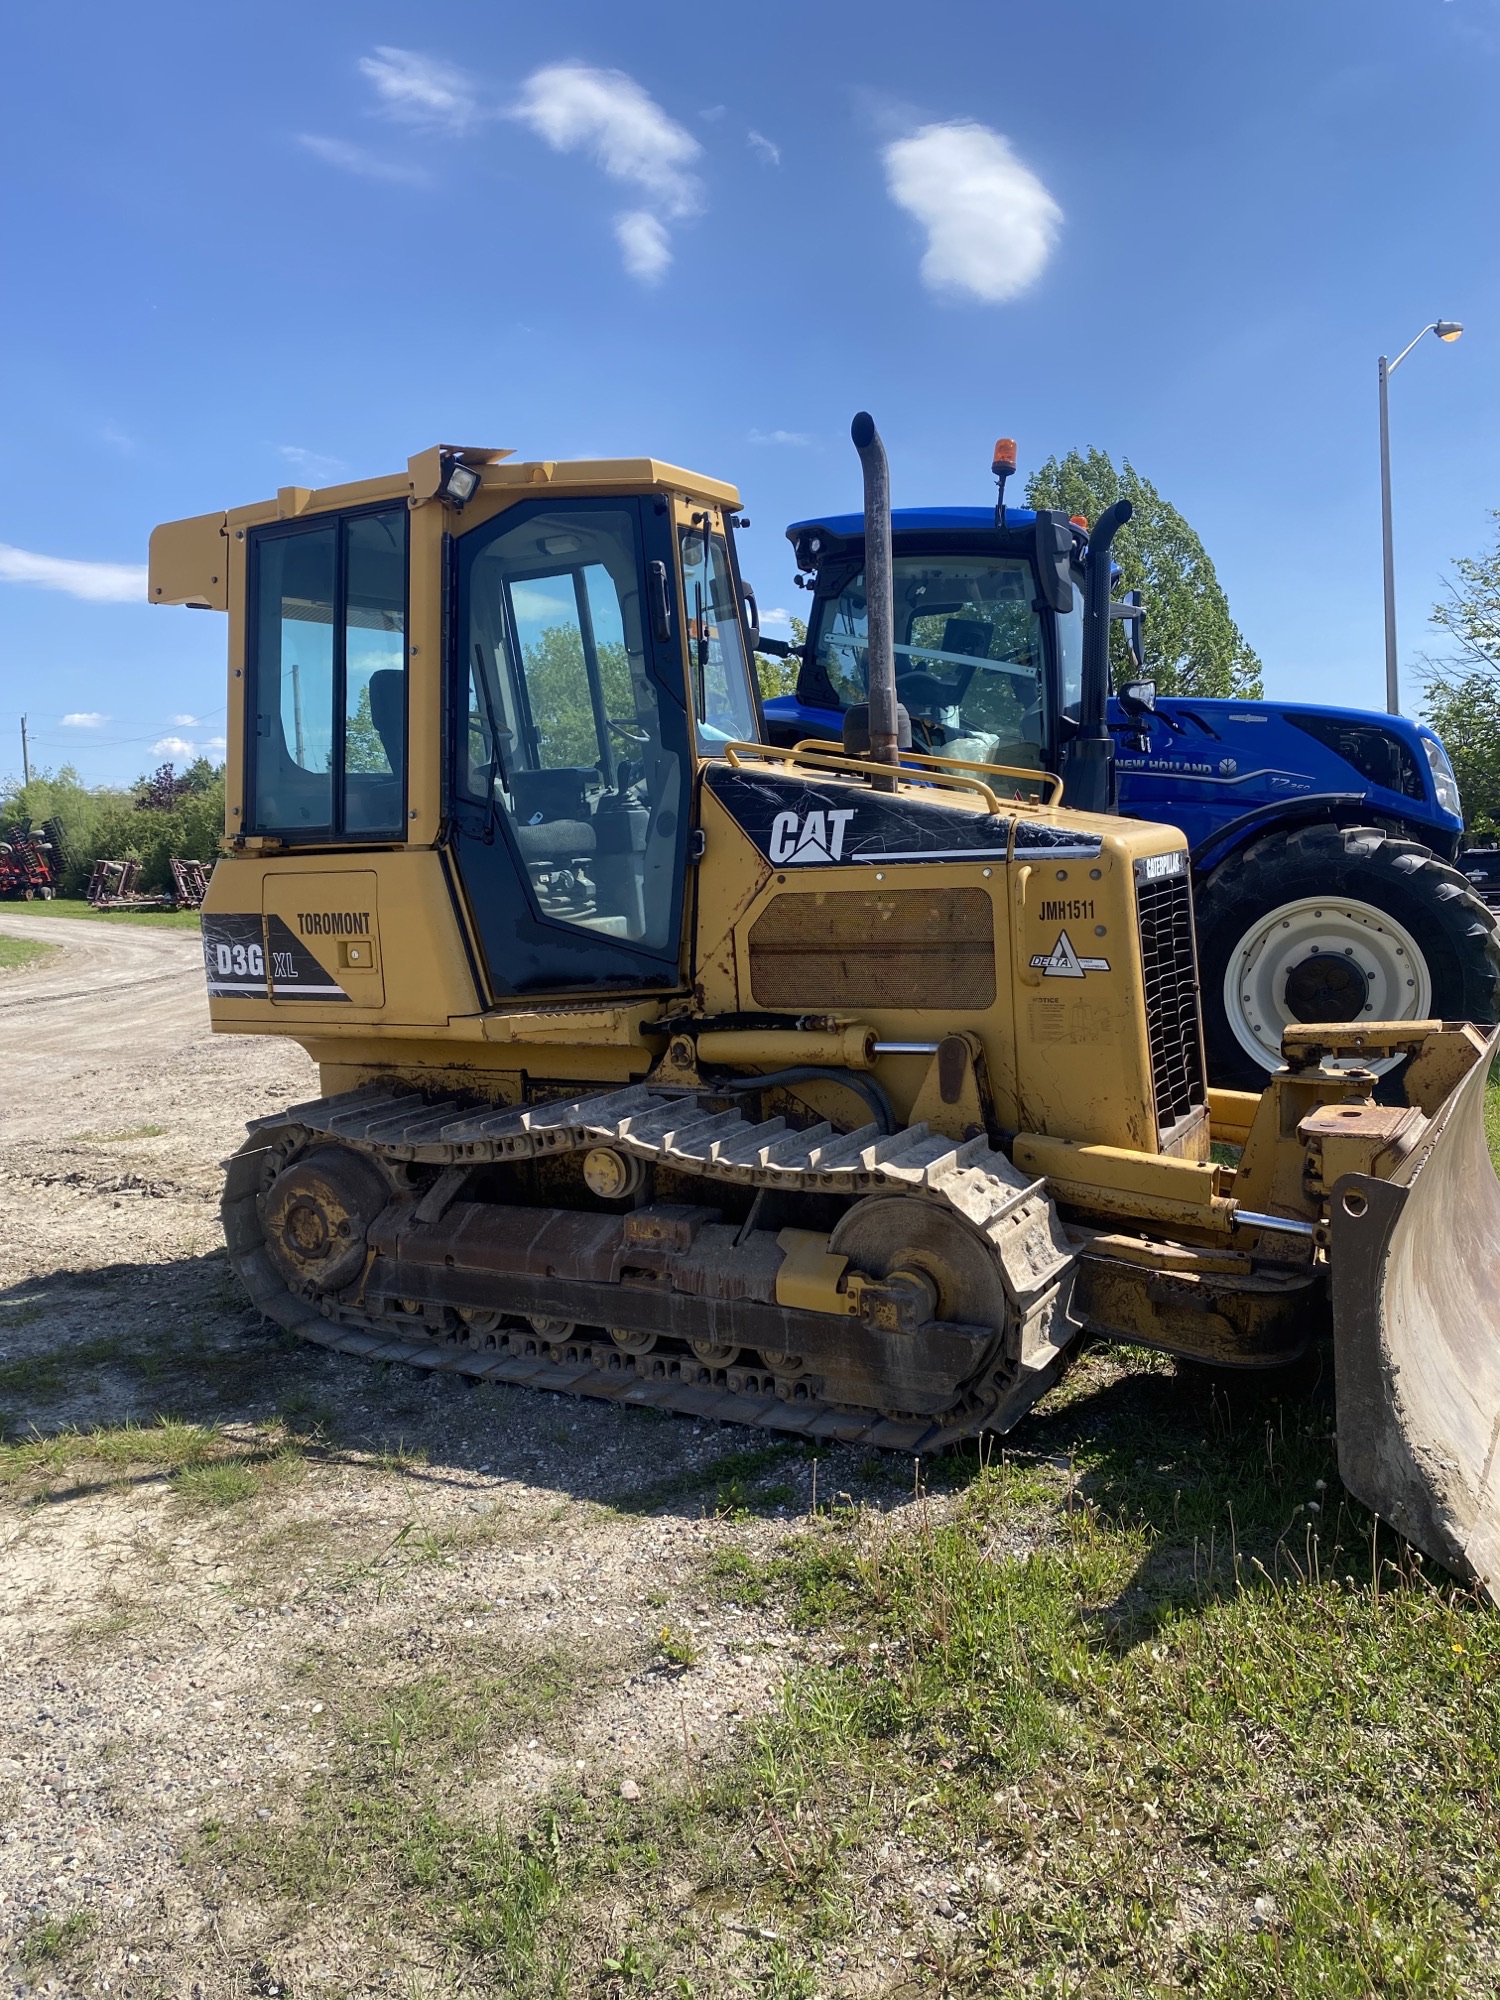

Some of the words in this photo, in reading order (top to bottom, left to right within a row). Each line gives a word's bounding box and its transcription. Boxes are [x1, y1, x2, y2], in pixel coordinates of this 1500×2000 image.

[1115, 759, 1145, 769] NEW
[1149, 760, 1212, 774] HOLLAND
[769, 809, 854, 863] CAT
[1039, 900, 1094, 921] JMH1511
[297, 912, 370, 935] TOROMONT
[216, 943, 264, 976] D3G
[272, 952, 299, 978] XL
[1032, 956, 1069, 967] DELTA
